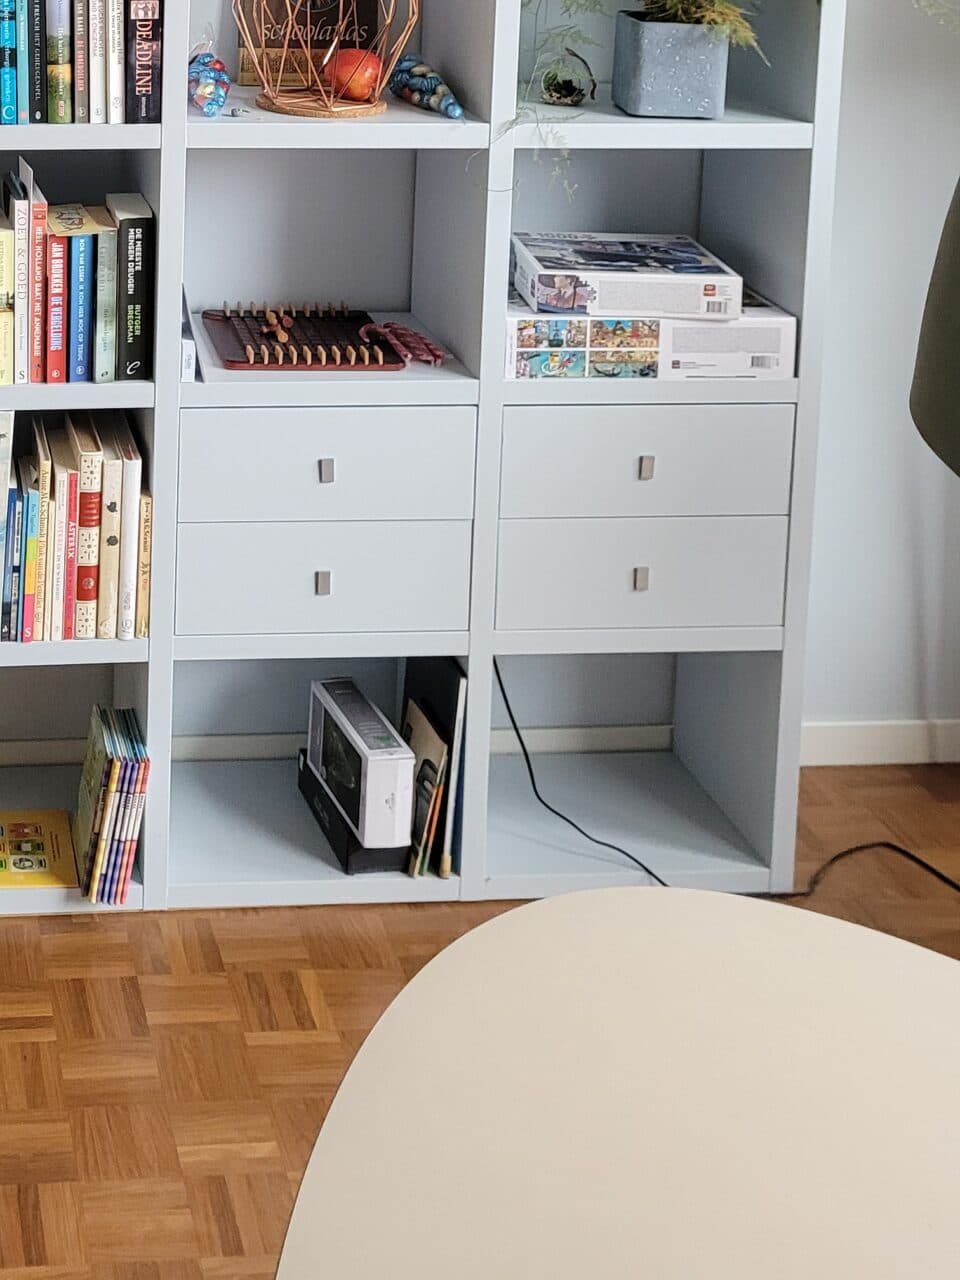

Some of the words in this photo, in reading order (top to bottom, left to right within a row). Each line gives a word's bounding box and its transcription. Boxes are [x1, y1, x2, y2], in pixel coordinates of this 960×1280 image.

[77, 3, 85, 15] VAN
[135, 20, 153, 96] DEADLINE
[16, 207, 28, 242] ZOET
[35, 226, 44, 243] HEEL
[135, 228, 143, 239] DE
[16, 247, 26, 260] &
[51, 242, 64, 258] JAN
[127, 228, 135, 261] MENSEN
[134, 241, 142, 272] MEESTE
[33, 245, 45, 281] HOLLAND
[50, 259, 64, 294] BROKKEN
[126, 262, 135, 295] DEUGEN
[16, 261, 27, 301] GOED
[34, 282, 42, 300] BAKT
[34, 301, 42, 316] MET
[52, 295, 63, 306] DE
[32, 316, 43, 357] ANNEMARIE
[51, 307, 63, 351] VERGELDING
[126, 304, 135, 343] BREGMAN
[134, 304, 143, 336] RUTGER
[67, 520, 76, 560] ASTERIX
